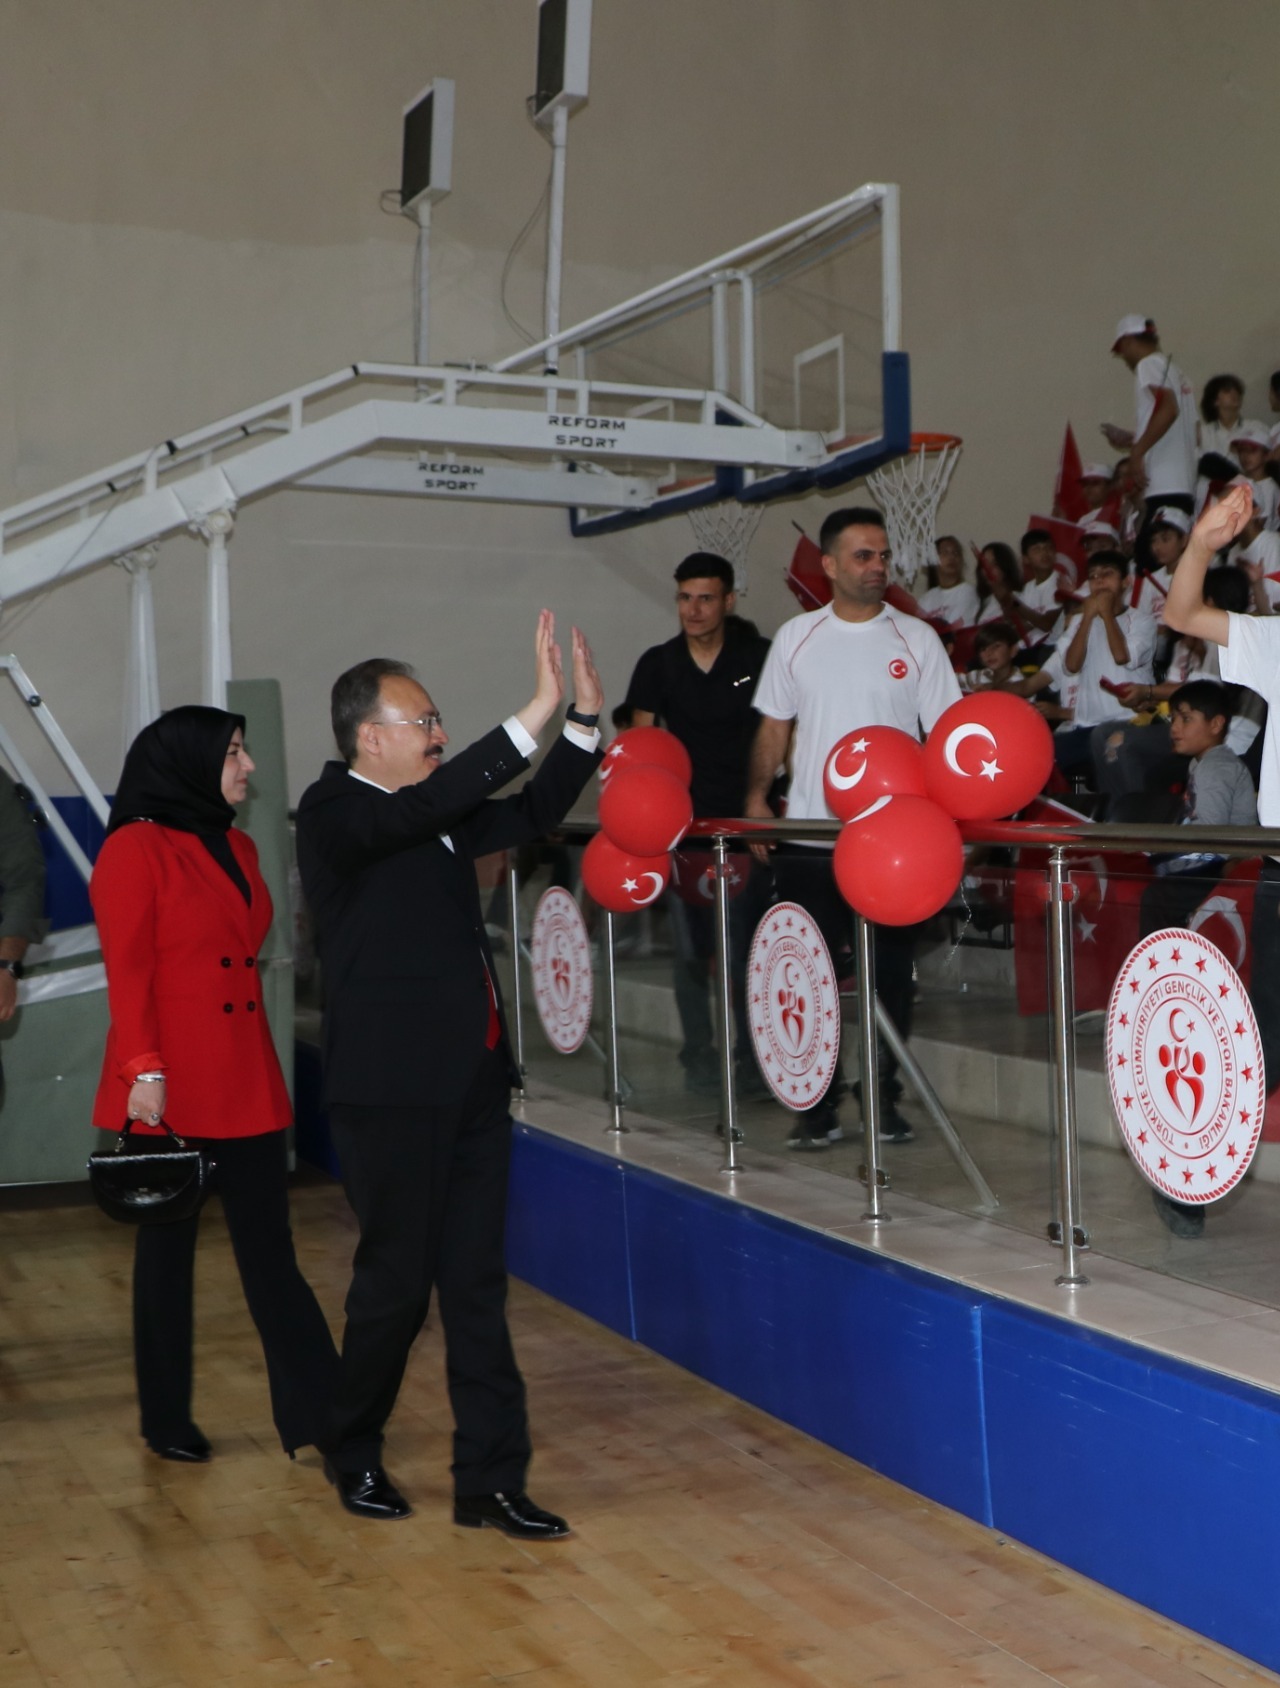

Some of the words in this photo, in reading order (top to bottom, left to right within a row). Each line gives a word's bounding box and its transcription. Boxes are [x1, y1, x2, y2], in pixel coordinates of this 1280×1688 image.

[548, 415, 626, 431] REFORM
[555, 434, 618, 449] SPORT
[418, 462, 484, 475] REFORM
[424, 479, 478, 491] SPORT
[1165, 980, 1207, 1008] GENÇLİK
[1208, 1003, 1220, 1026] VE
[1135, 984, 1163, 1086] CUMHURİYETİ
[1217, 1026, 1232, 1072] SPOR
[1141, 1089, 1175, 1146] TÜRKİYE
[1199, 1077, 1233, 1150] BAKANLIĞI
